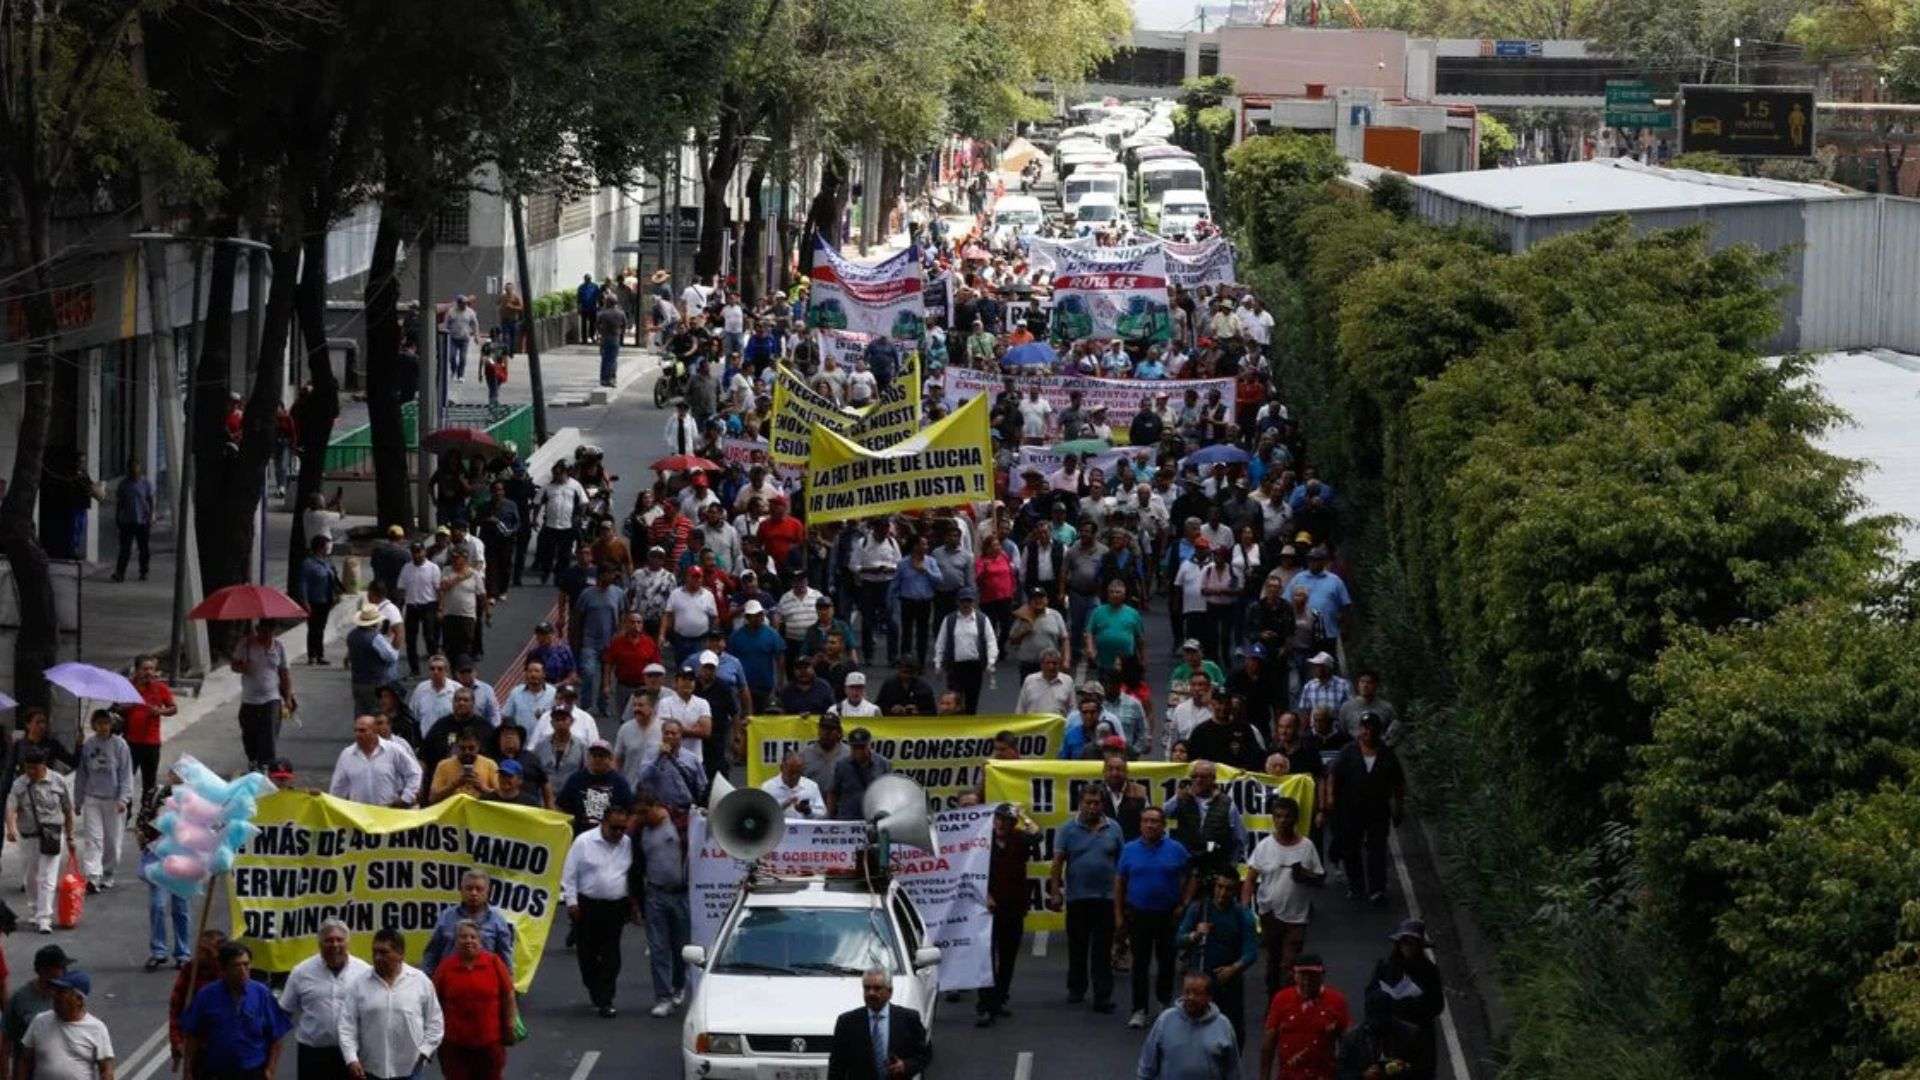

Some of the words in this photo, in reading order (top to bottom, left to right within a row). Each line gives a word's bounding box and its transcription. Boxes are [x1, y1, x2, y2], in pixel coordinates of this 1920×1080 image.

[901, 452, 922, 473] DE
[925, 447, 983, 470] LUCHA
[825, 490, 855, 510] UNA
[857, 480, 910, 506] TARIFA
[914, 474, 966, 498] JUSTA
[899, 734, 1048, 760] CONCESIODO
[253, 821, 311, 856] MÁS
[316, 828, 346, 857] DE
[782, 851, 848, 862] GOBIERNO
[233, 867, 338, 898] ERVICIO
[342, 864, 357, 893] Y
[367, 860, 414, 890] SIN
[243, 910, 277, 939] DE
